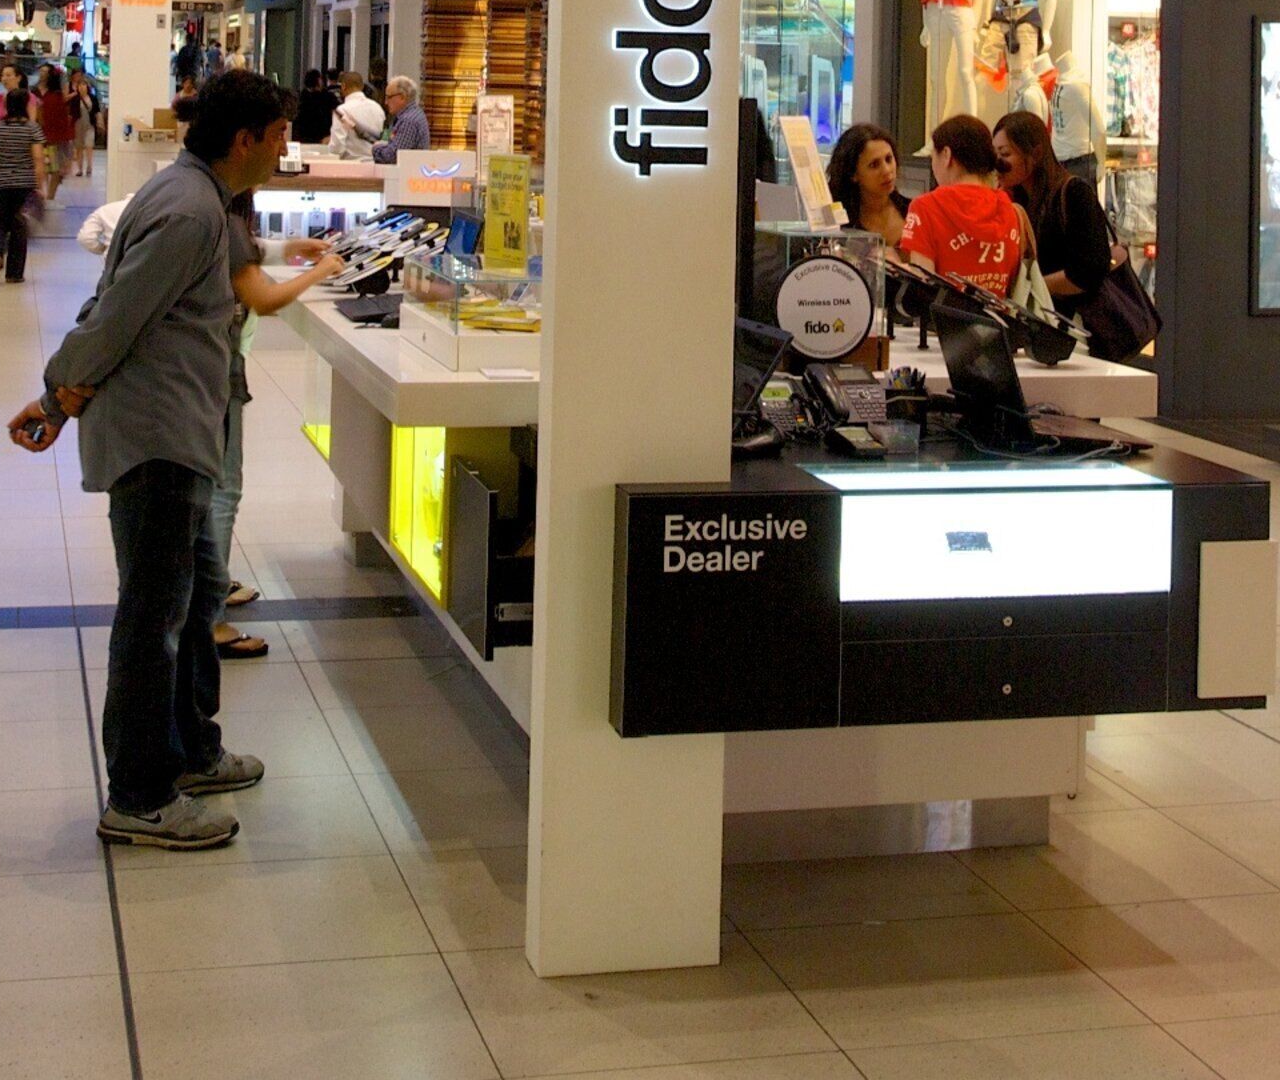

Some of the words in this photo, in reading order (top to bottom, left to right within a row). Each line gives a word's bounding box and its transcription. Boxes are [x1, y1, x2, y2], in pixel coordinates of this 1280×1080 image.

[978, 241, 1005, 263] 73
[798, 299, 832, 307] Wireless
[805, 321, 830, 334] fido
[664, 513, 808, 542] Exclusive
[663, 544, 765, 573] Dealer
